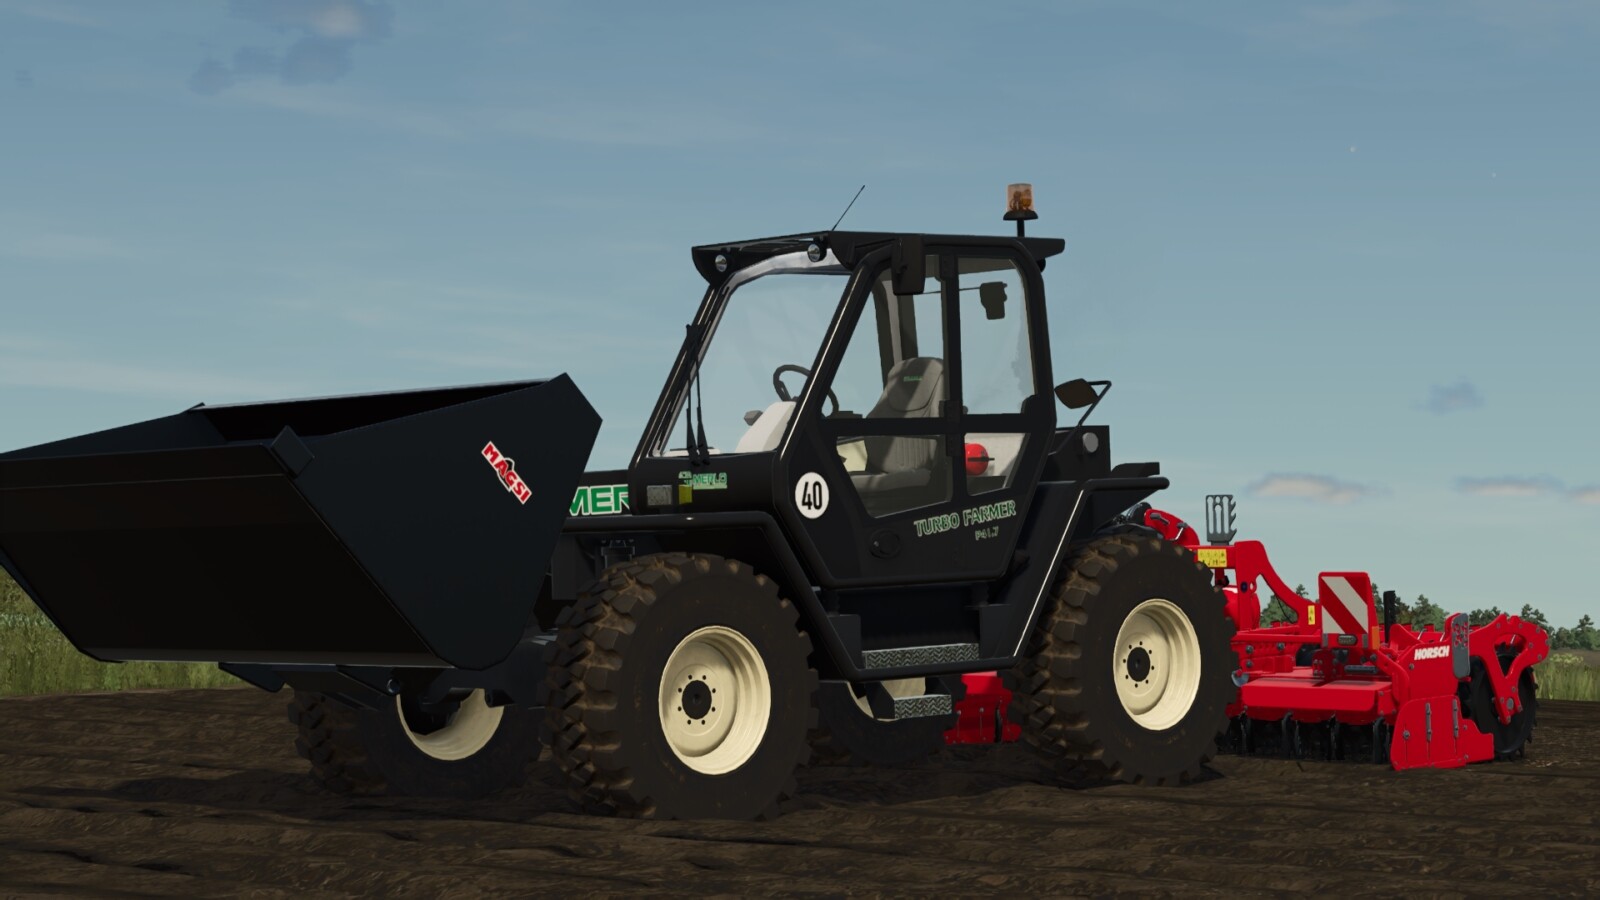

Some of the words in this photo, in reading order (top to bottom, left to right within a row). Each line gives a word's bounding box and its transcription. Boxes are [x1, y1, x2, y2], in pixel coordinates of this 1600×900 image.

[483, 444, 530, 502] MAGSI
[801, 481, 823, 511] 40
[913, 512, 960, 537] TURBO
[962, 500, 1017, 526] FARMER
[1413, 645, 1450, 661] HORSCH
